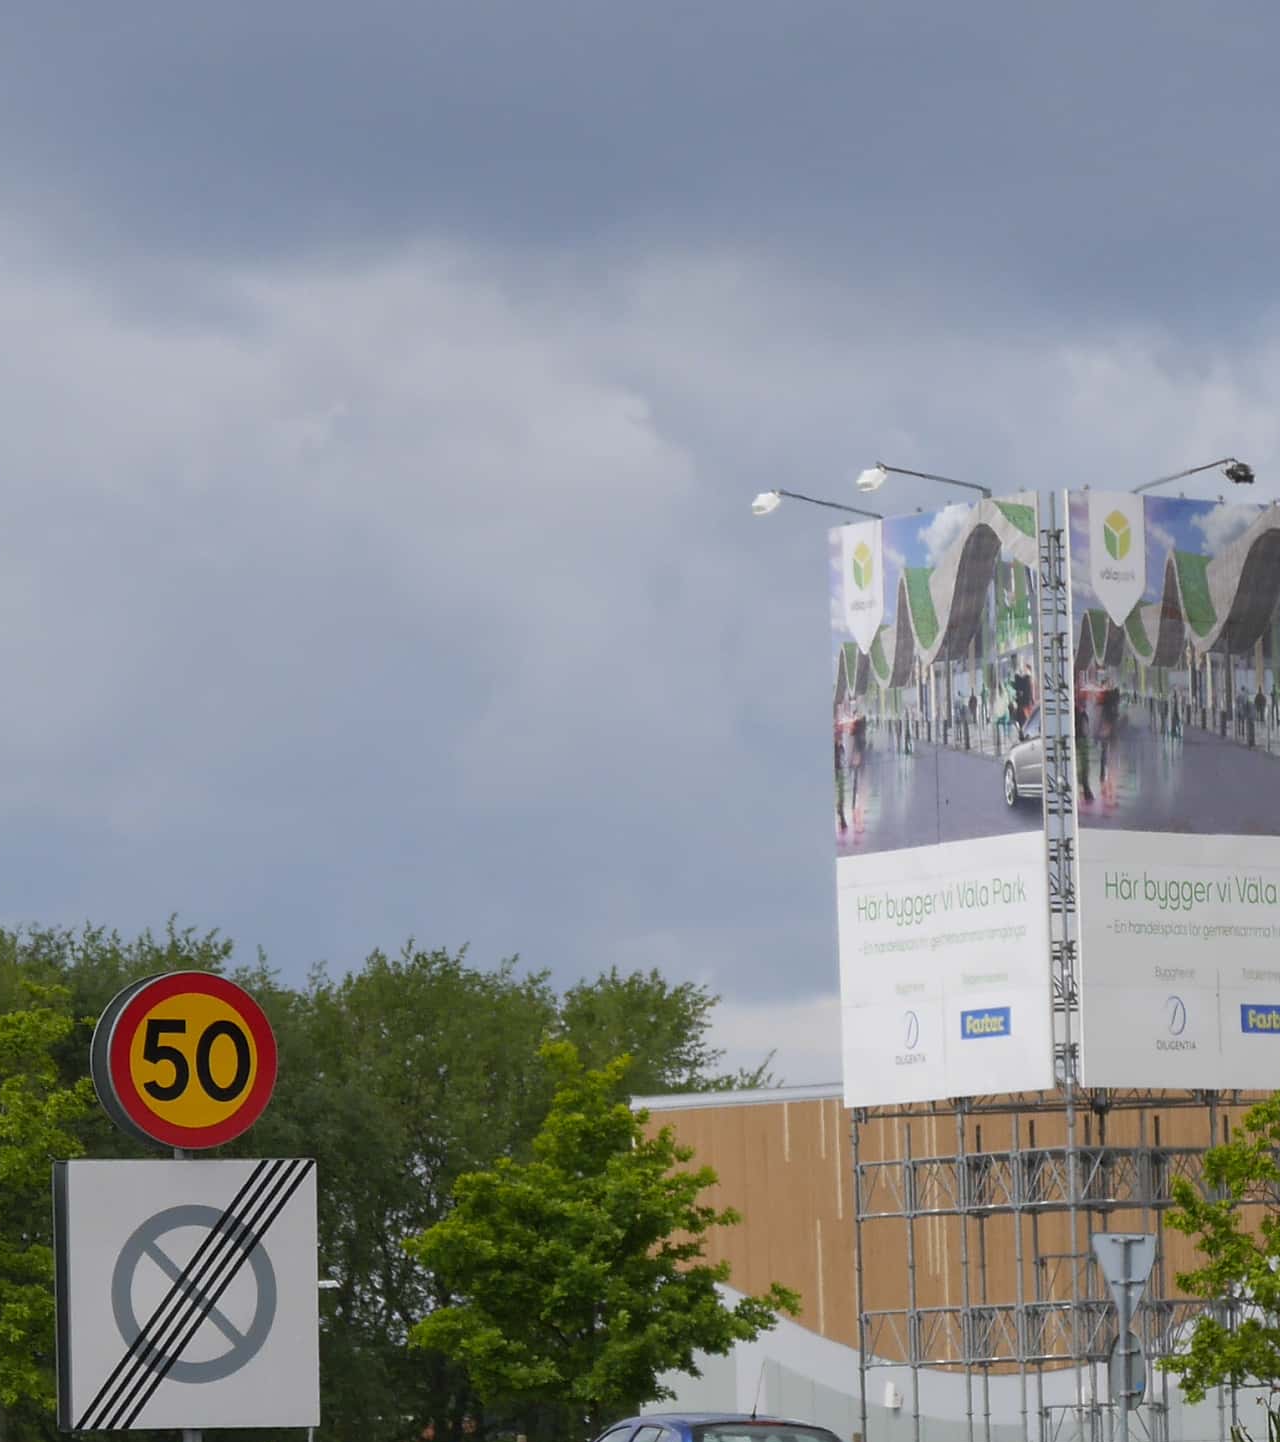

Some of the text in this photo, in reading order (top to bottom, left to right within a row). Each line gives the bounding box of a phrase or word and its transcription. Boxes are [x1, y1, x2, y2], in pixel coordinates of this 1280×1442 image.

[856, 895, 883, 923] Här
[886, 891, 937, 927] bygger
[941, 881, 953, 911] vi
[992, 873, 1026, 904] Park
[1104, 871, 1138, 900] Här
[1143, 871, 1212, 911] bygger
[1216, 876, 1231, 903] vi
[1235, 875, 1277, 904] Väla
[143, 1018, 251, 1102] 50
